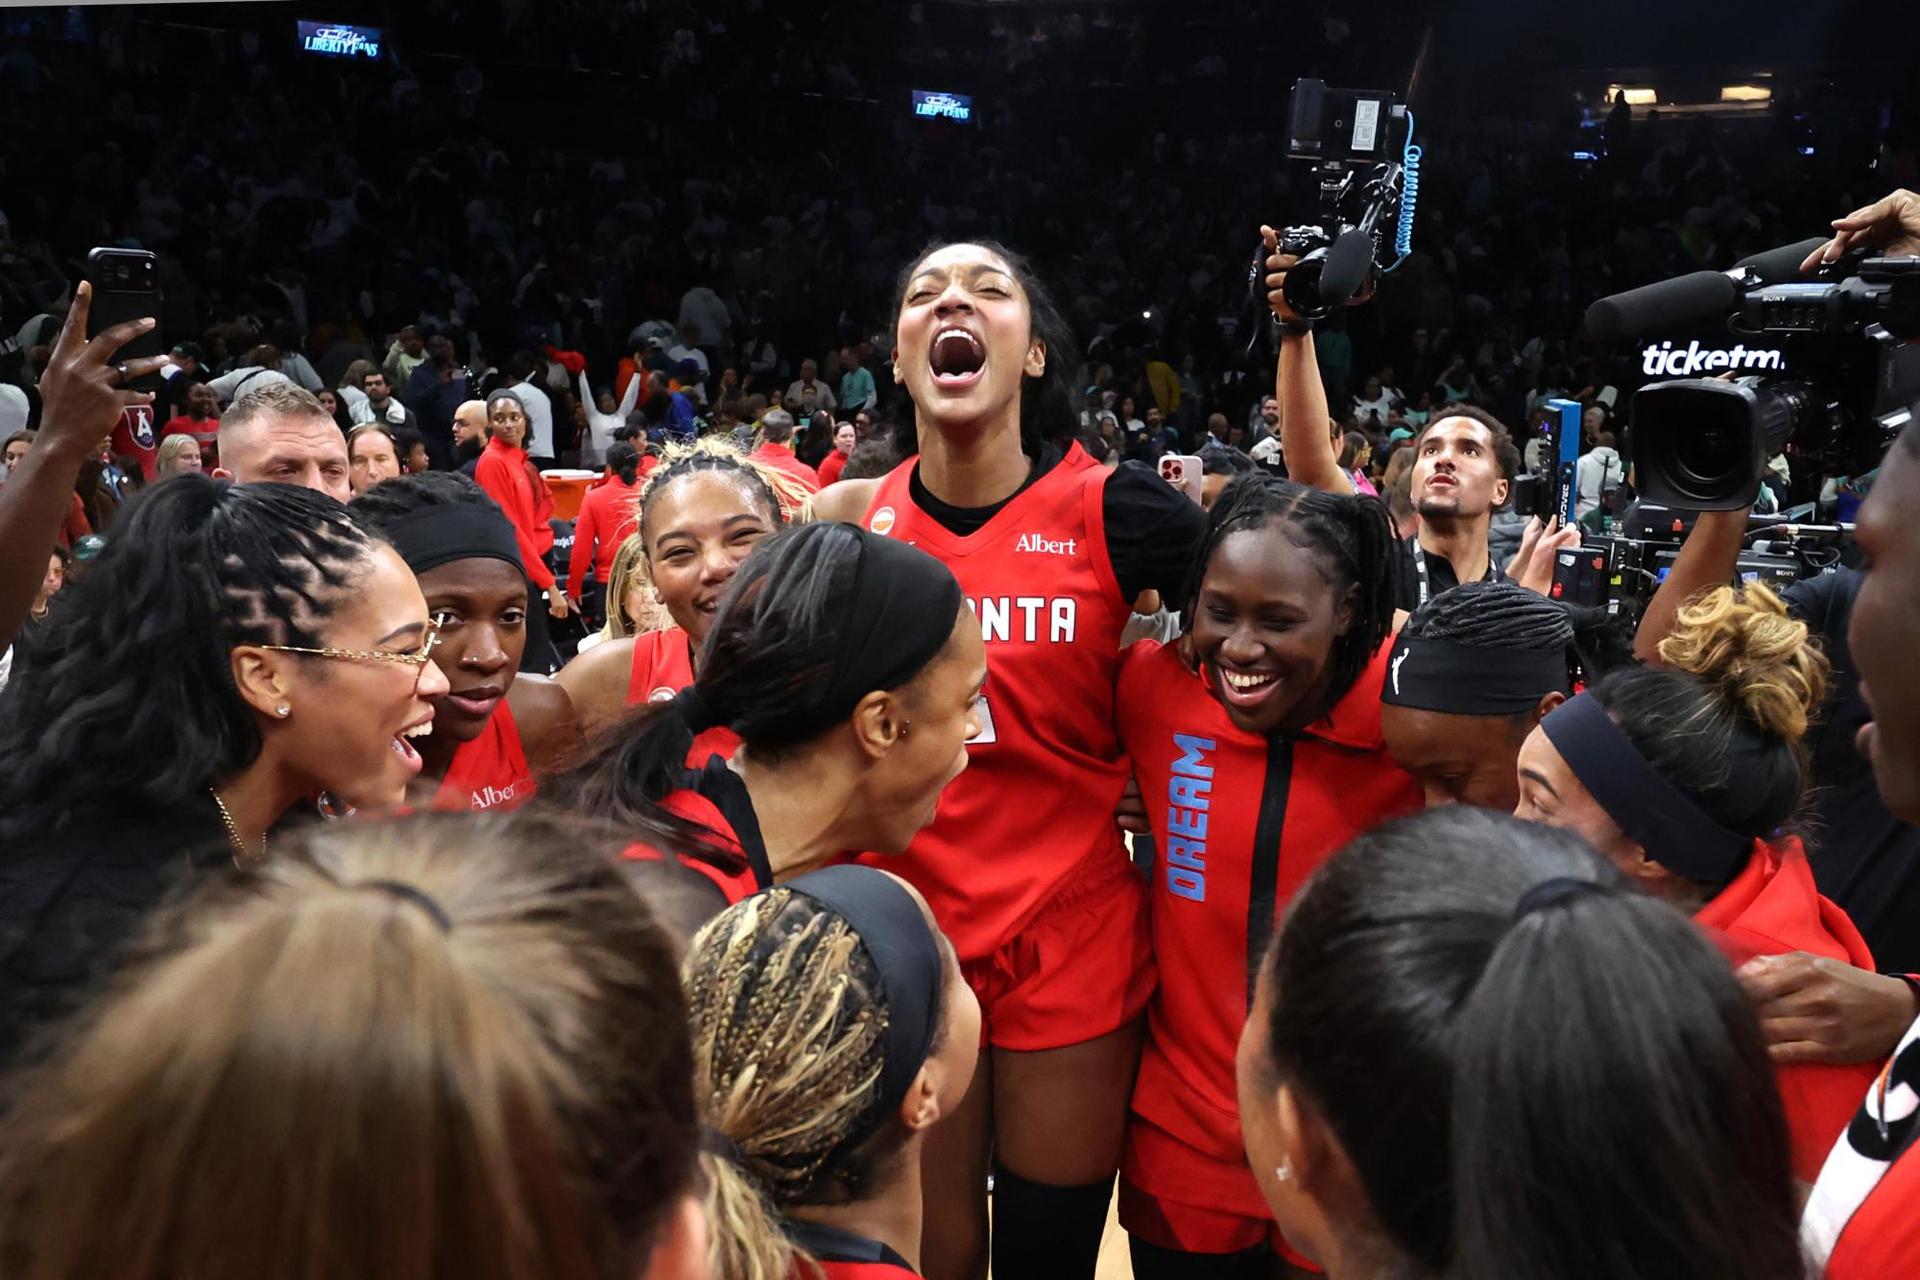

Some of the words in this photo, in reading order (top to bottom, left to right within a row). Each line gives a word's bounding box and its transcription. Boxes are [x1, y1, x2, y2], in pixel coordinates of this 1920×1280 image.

[1642, 340, 1785, 375] ticketm
[1015, 533, 1076, 556] Albert
[471, 783, 515, 809] Alber
[1167, 732, 1216, 902] DREAM
